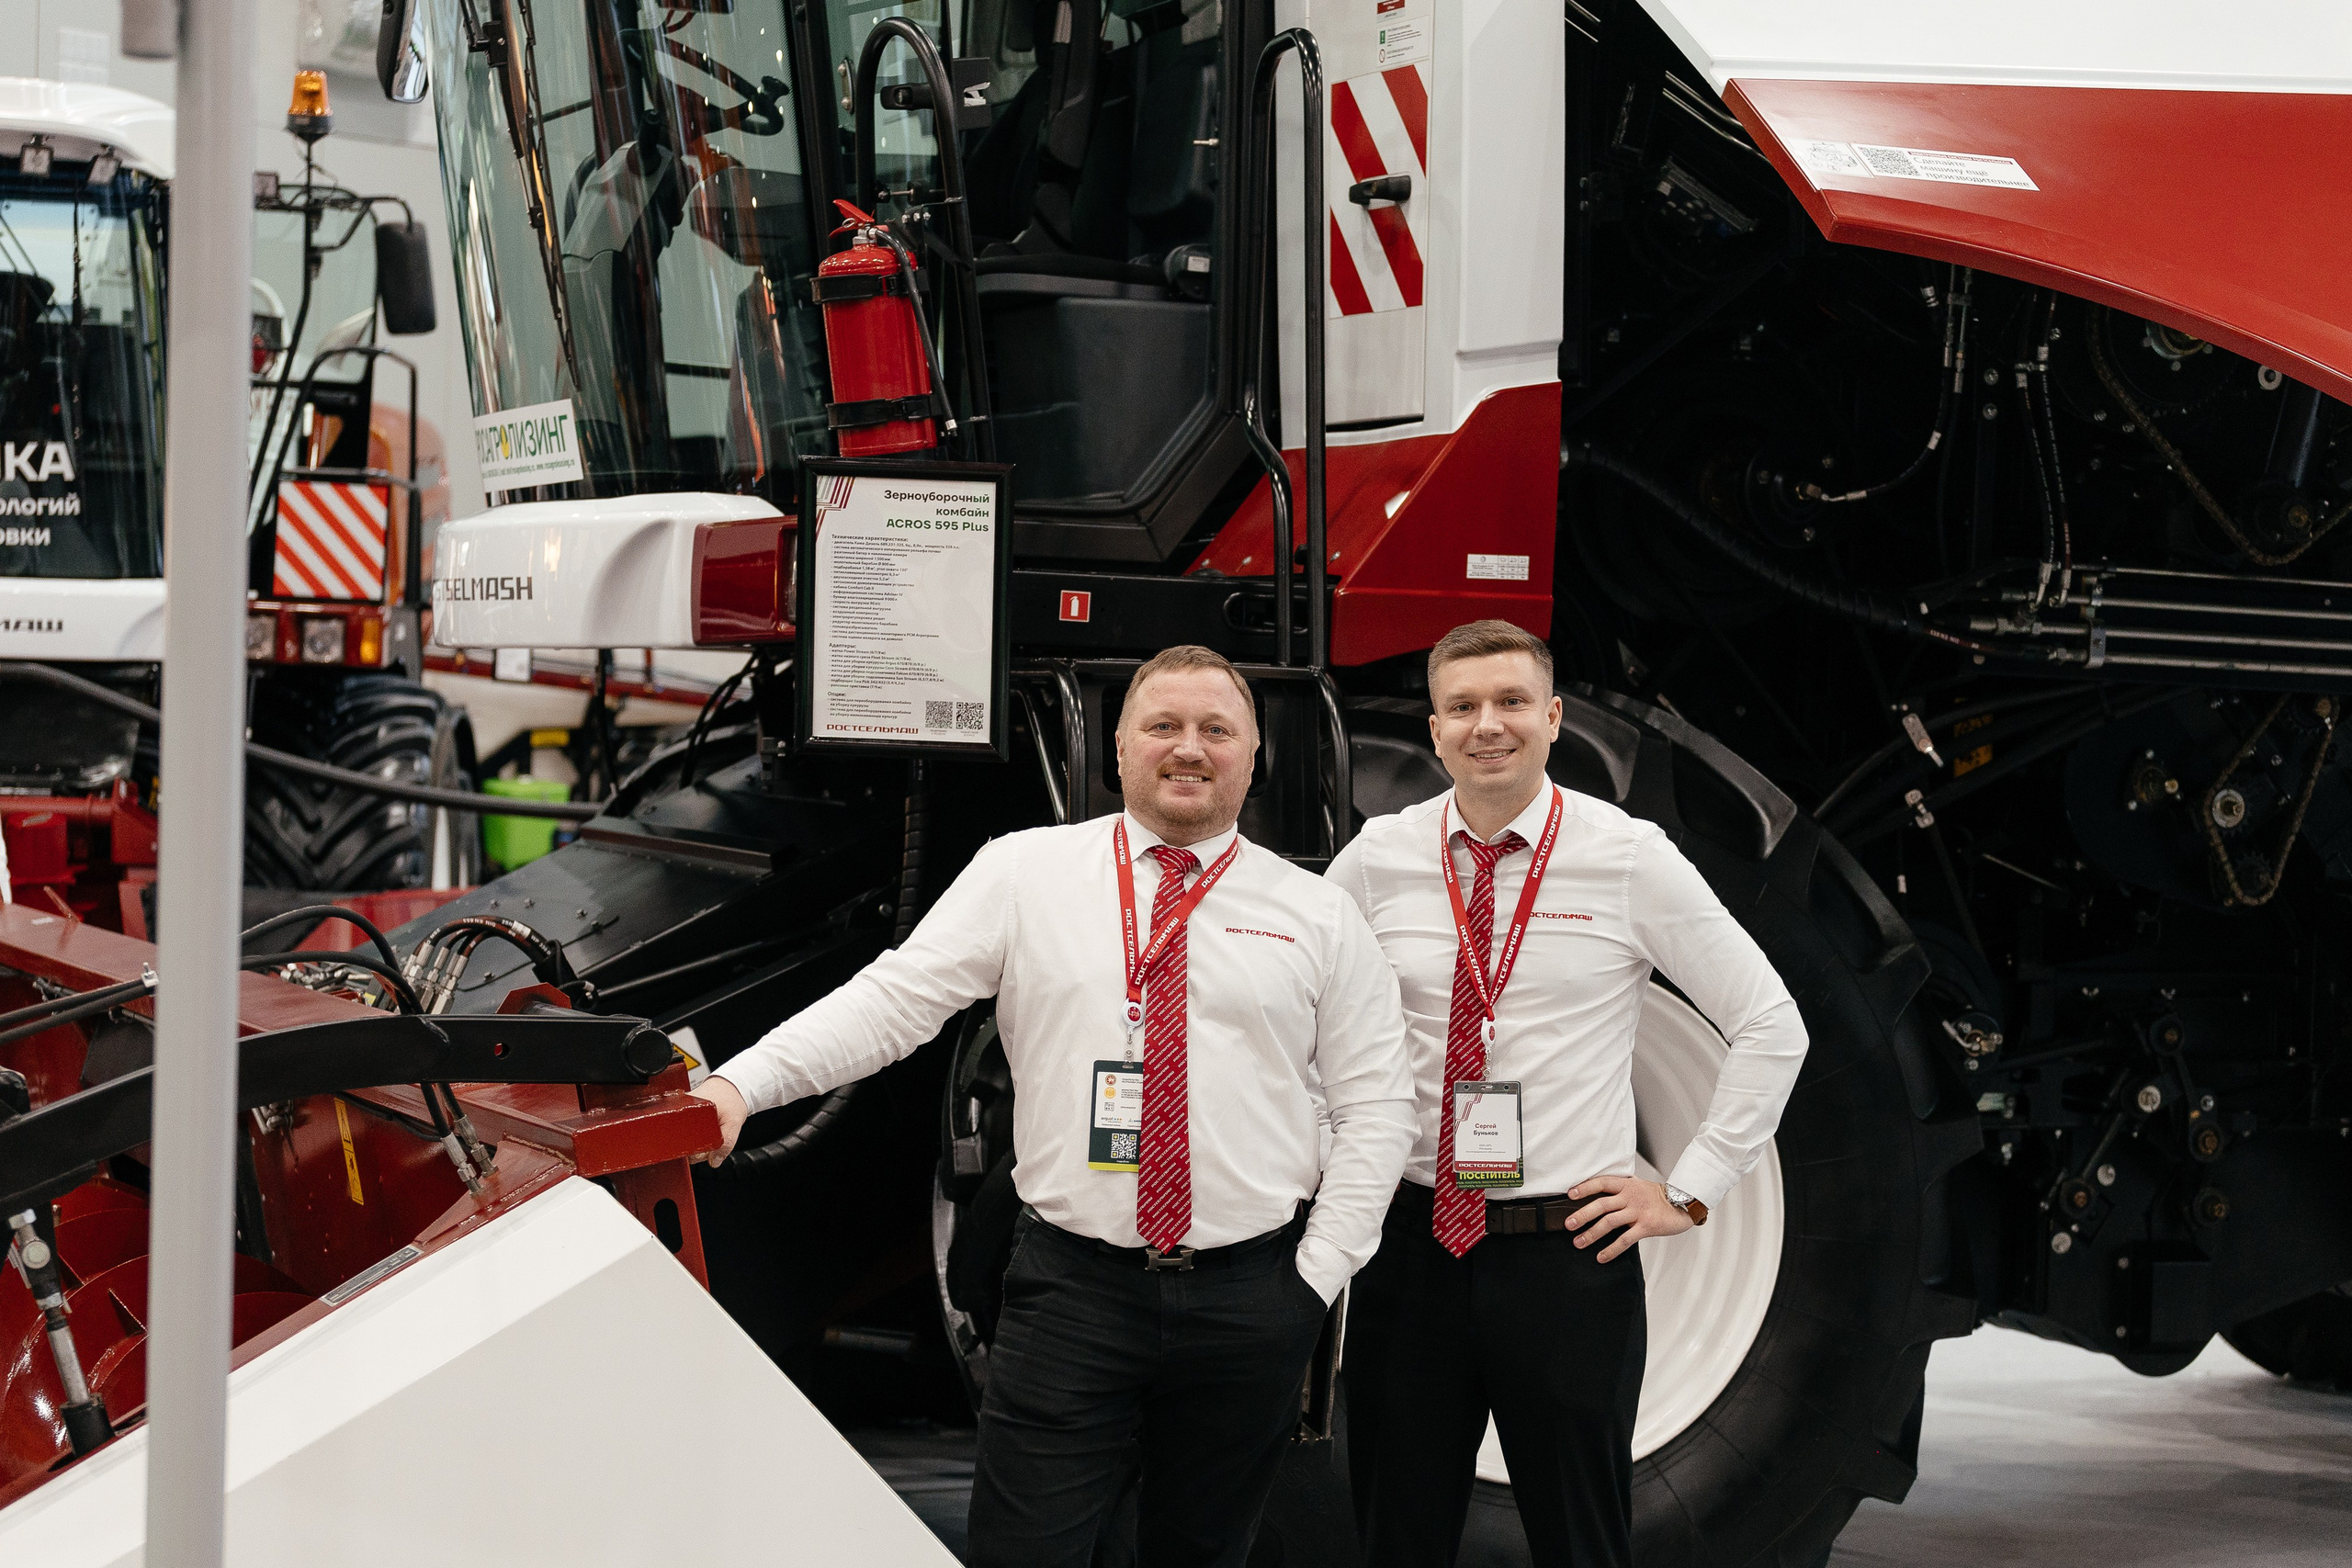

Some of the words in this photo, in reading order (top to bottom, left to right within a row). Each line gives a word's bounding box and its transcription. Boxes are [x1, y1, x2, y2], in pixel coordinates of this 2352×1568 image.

[1913, 156, 1965, 167] Сделайте
[1919, 164, 1966, 175] машину
[1926, 172, 2030, 187] производительнее
[0, 441, 75, 482] КА
[884, 490, 989, 503] Зерноуборочный
[935, 507, 989, 517] комбайн
[886, 518, 932, 529] ACROS
[934, 520, 958, 531] 595
[962, 521, 989, 532] Plus
[826, 724, 919, 735] РОСТСЕЛЬМАШ
[1532, 804, 1561, 879] РОСТСЕЛЬМАШ
[1530, 911, 1593, 921] ОСТСЕЛЬМАШ
[1225, 927, 1295, 943] РОСТСЕЛЬМАШ
[1135, 917, 1180, 986] РОСТСЕЛЬМАШ
[1489, 923, 1522, 1007] РОСТСЕЛЬМАШ
[1459, 1171, 1521, 1179] ПОСЕТИТЕЛЬ
